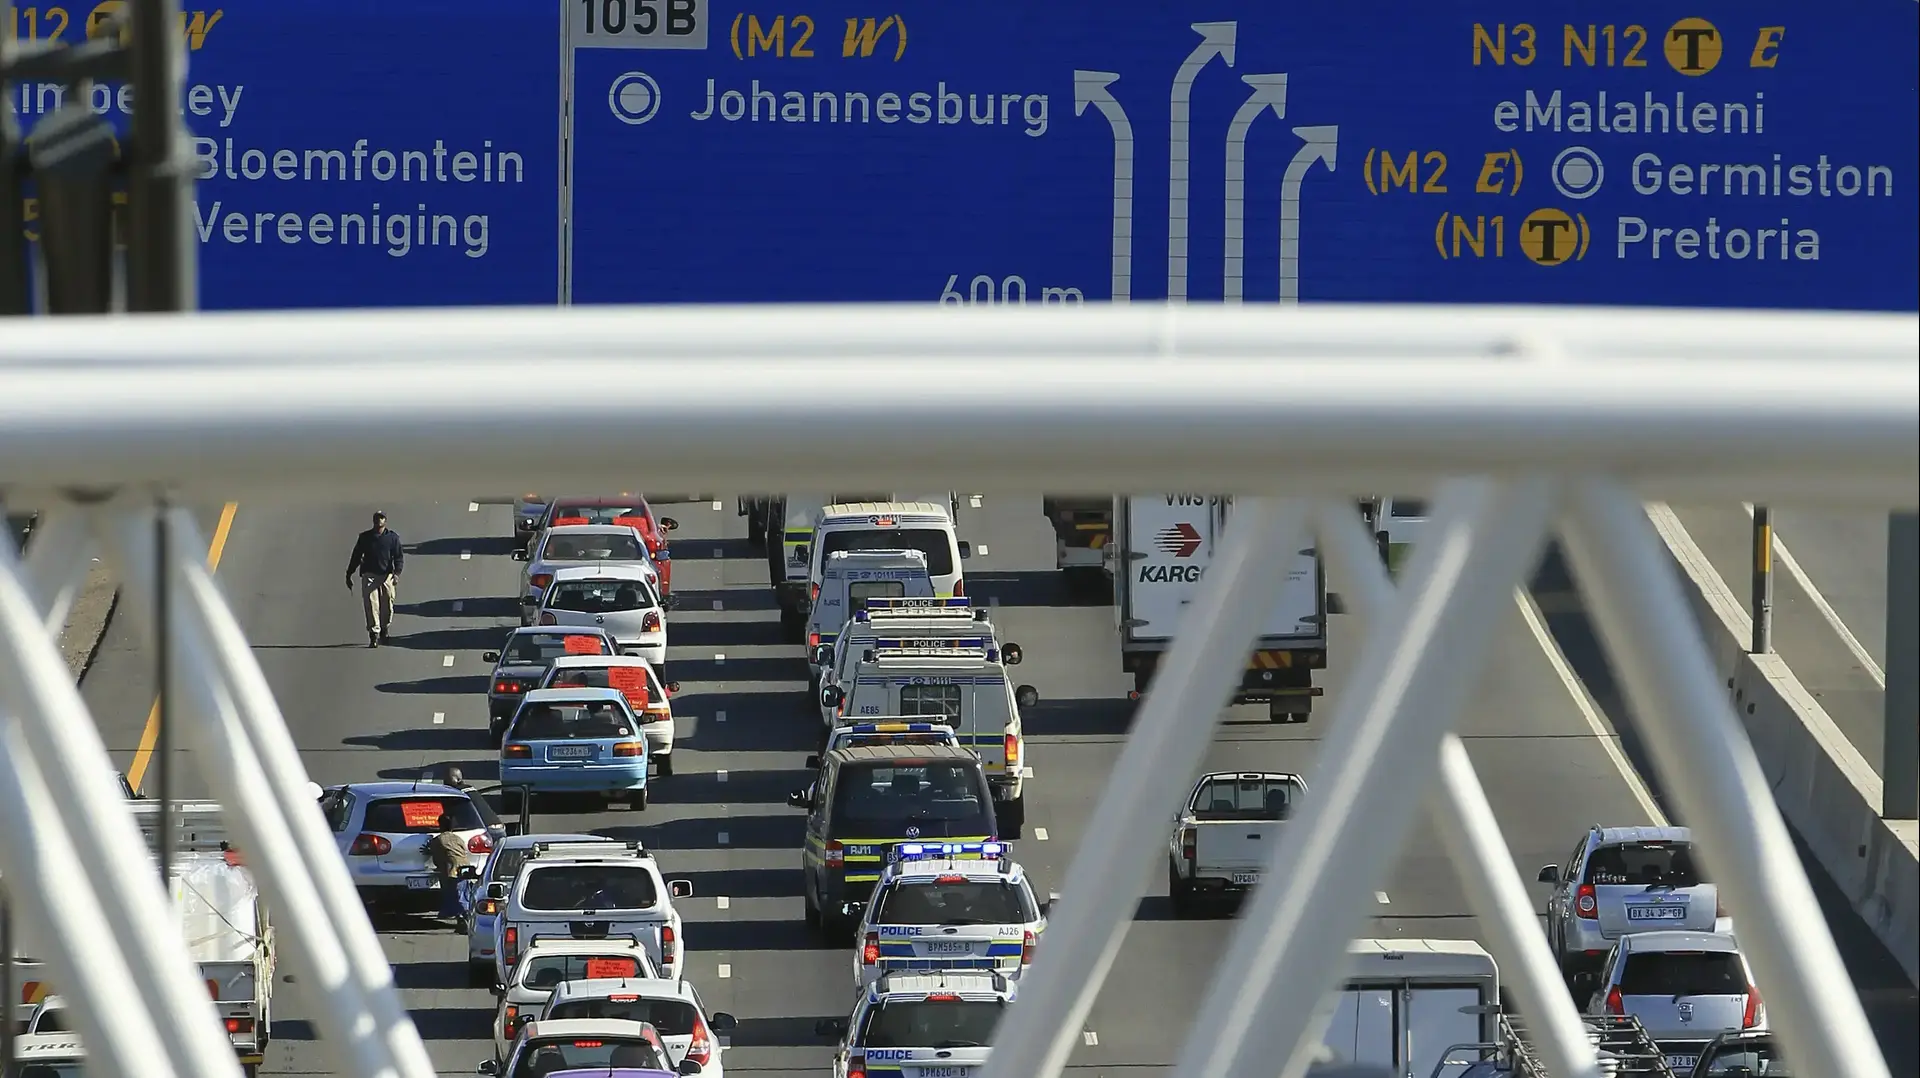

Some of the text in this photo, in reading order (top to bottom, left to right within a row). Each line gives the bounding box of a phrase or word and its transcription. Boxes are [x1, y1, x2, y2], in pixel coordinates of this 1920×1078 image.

[9, 7, 69, 48] 12
[582, 0, 696, 35] 105B
[730, 13, 814, 60] (M2
[1473, 23, 1537, 67] N3
[1563, 25, 1648, 67] N12
[1750, 26, 1786, 68] E
[690, 78, 1049, 137] Johannesburg
[1493, 90, 1764, 134] eMalahleni
[191, 136, 523, 183] Bloemfontein
[1364, 148, 1893, 197] (M2 E) Germiston
[192, 200, 489, 258] Vereeniging
[1435, 211, 1504, 260] (N1
[1617, 216, 1820, 261] Pretoria
[1139, 564, 1209, 583] KARG
[913, 640, 946, 648] POLICE
[860, 705, 880, 715] AE85
[850, 845, 871, 855] RJ11
[880, 926, 922, 936] POLICE
[998, 927, 1019, 936] AJ26
[866, 1049, 913, 1060] POLICE
[1671, 1056, 1683, 1066] 32
